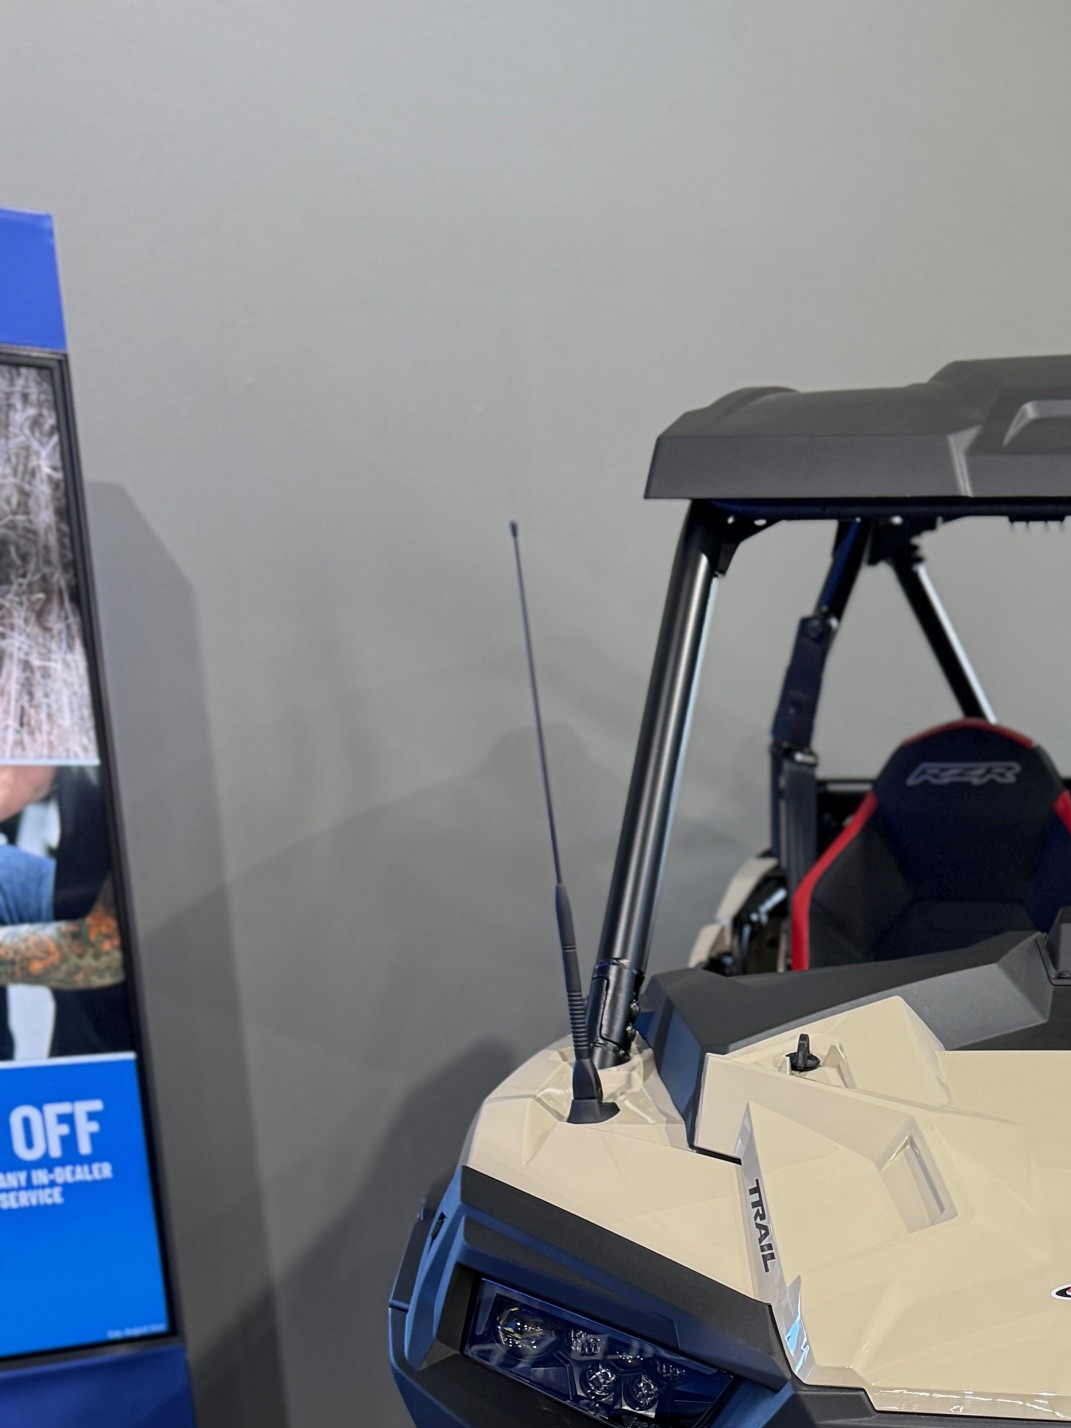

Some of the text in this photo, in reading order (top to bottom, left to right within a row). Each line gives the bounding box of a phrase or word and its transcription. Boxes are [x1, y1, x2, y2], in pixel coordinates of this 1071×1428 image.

[907, 761, 1021, 787] RZR
[9, 1099, 104, 1161] OFF
[30, 1162, 113, 1186] IN-DEALER
[0, 1186, 64, 1209] SERVICE
[748, 1178, 776, 1273] TRAIL
